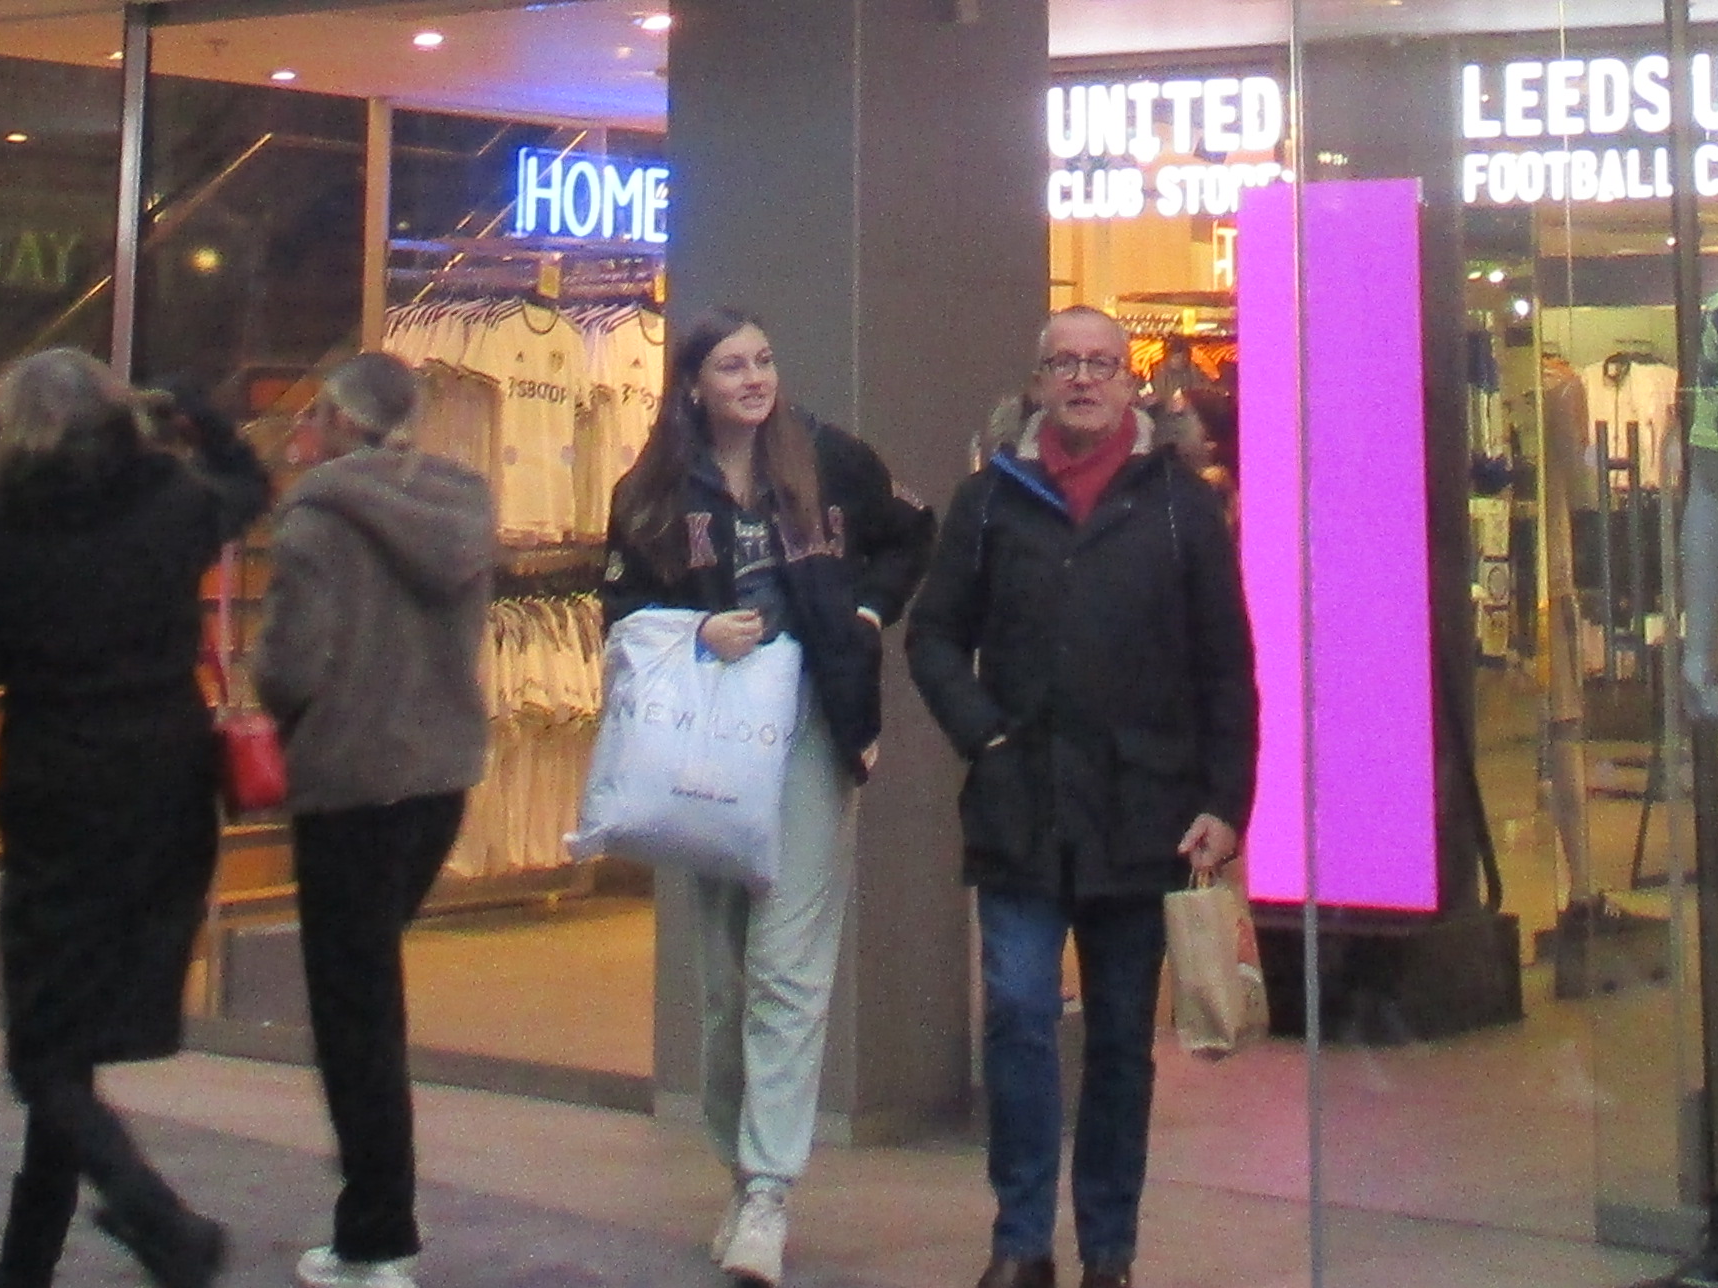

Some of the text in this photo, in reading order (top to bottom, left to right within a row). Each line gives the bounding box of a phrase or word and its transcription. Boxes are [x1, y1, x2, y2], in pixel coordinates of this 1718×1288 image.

[1047, 77, 1282, 162] UNITED
[1463, 55, 1671, 138] LEEDS
[525, 155, 669, 243] HOME
[1047, 168, 1144, 220] CLUB
[1463, 148, 1673, 203] FOOTBALL
